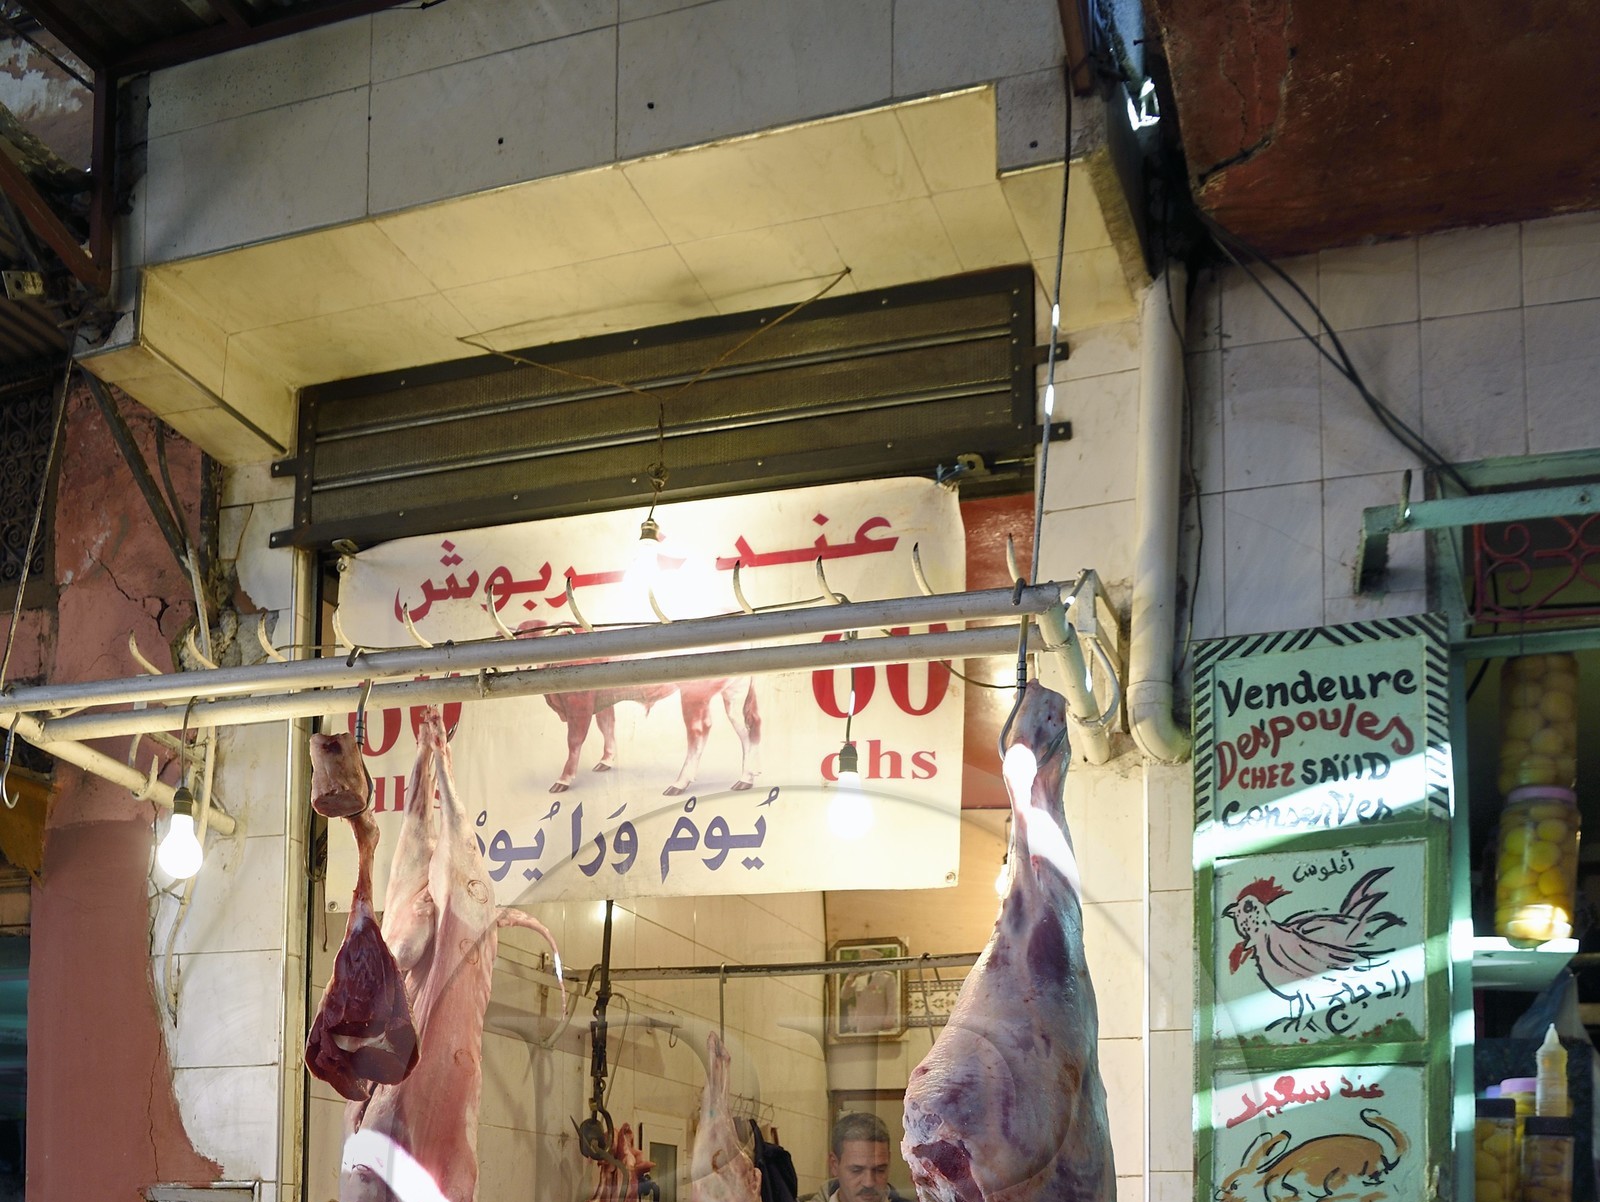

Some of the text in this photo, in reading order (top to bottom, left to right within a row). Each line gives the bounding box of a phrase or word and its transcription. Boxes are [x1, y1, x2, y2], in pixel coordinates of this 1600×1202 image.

[716, 513, 899, 571] عند
[1217, 669, 1417, 717] Vendeure
[1238, 762, 1295, 790] CHEZ
[1226, 1075, 1331, 1128] سعيد
